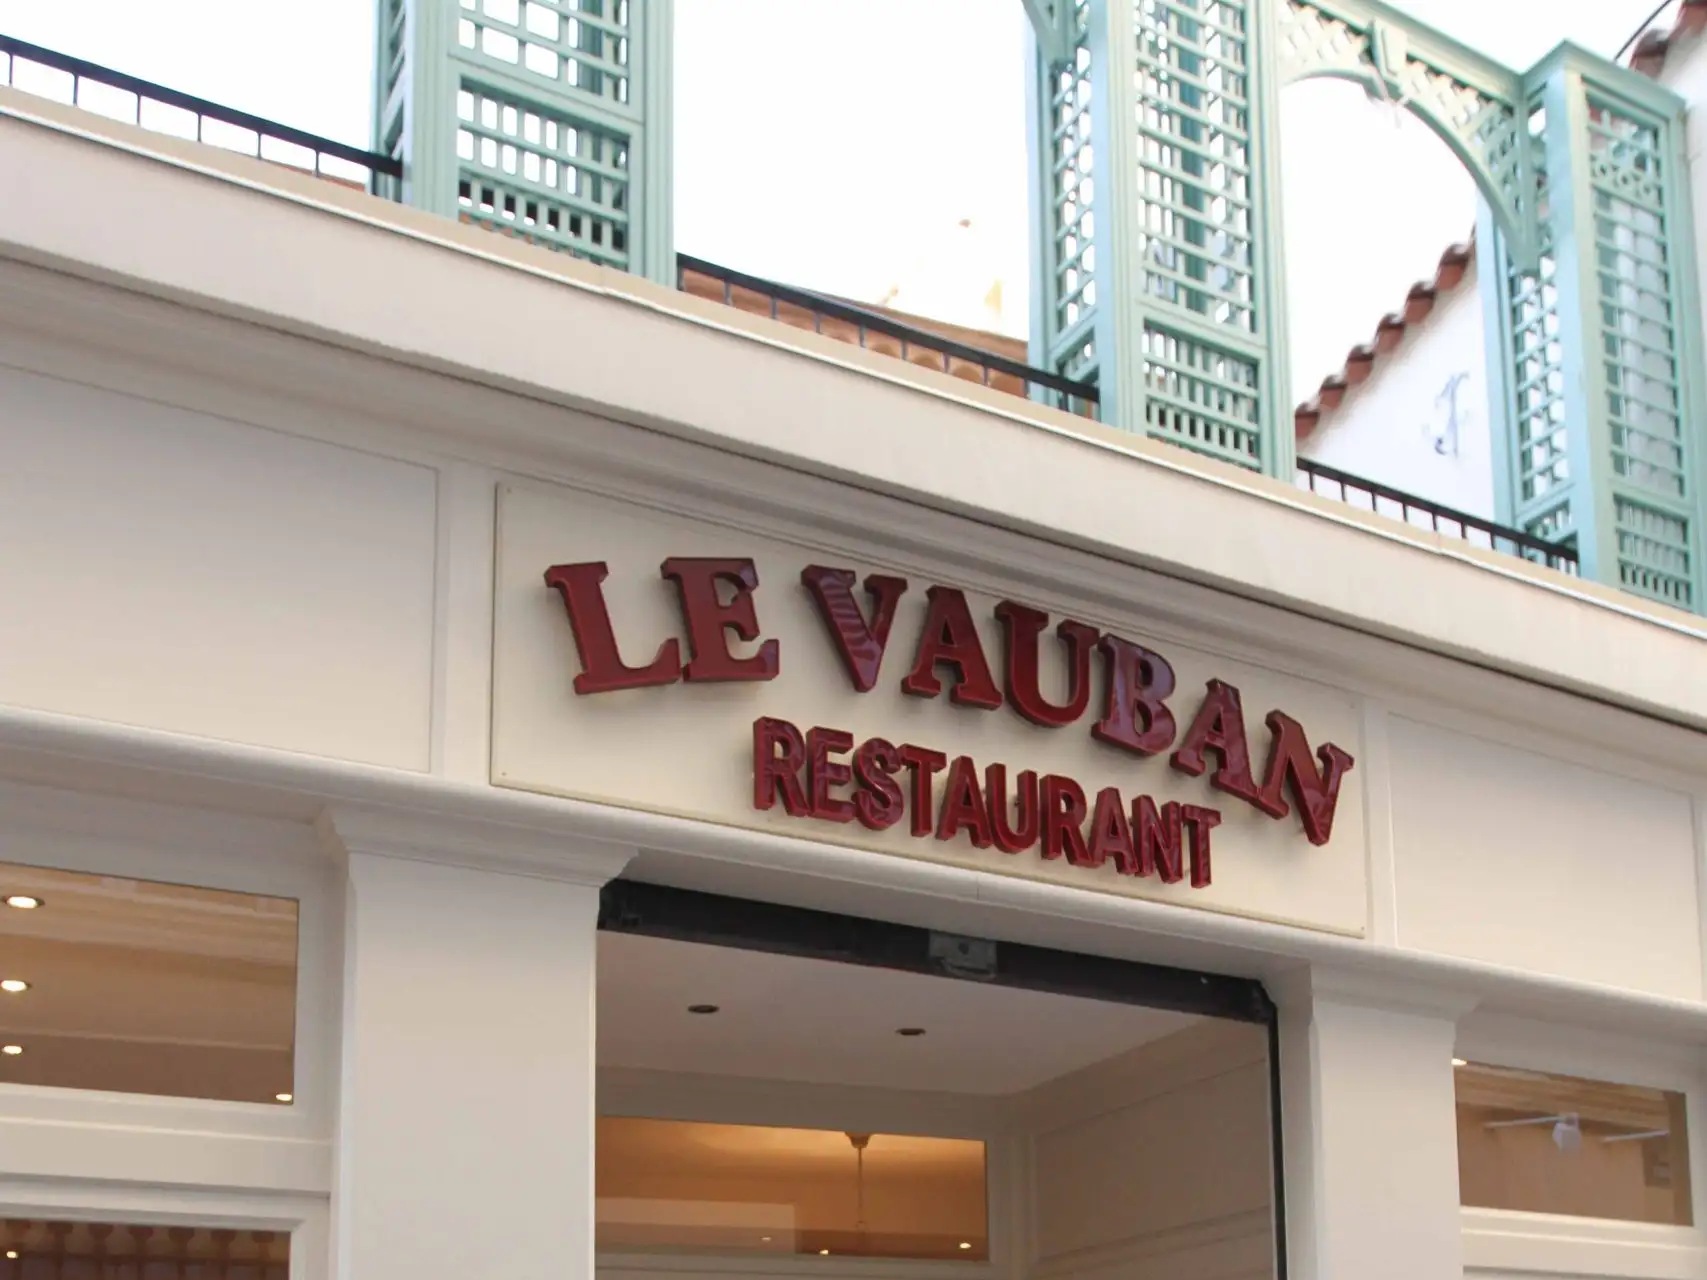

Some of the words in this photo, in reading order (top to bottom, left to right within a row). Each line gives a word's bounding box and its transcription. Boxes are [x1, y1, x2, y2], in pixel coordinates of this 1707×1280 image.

[544, 556, 780, 695] LE
[800, 564, 1354, 846] VAUBAN
[752, 716, 1221, 889] RESTAURANT
